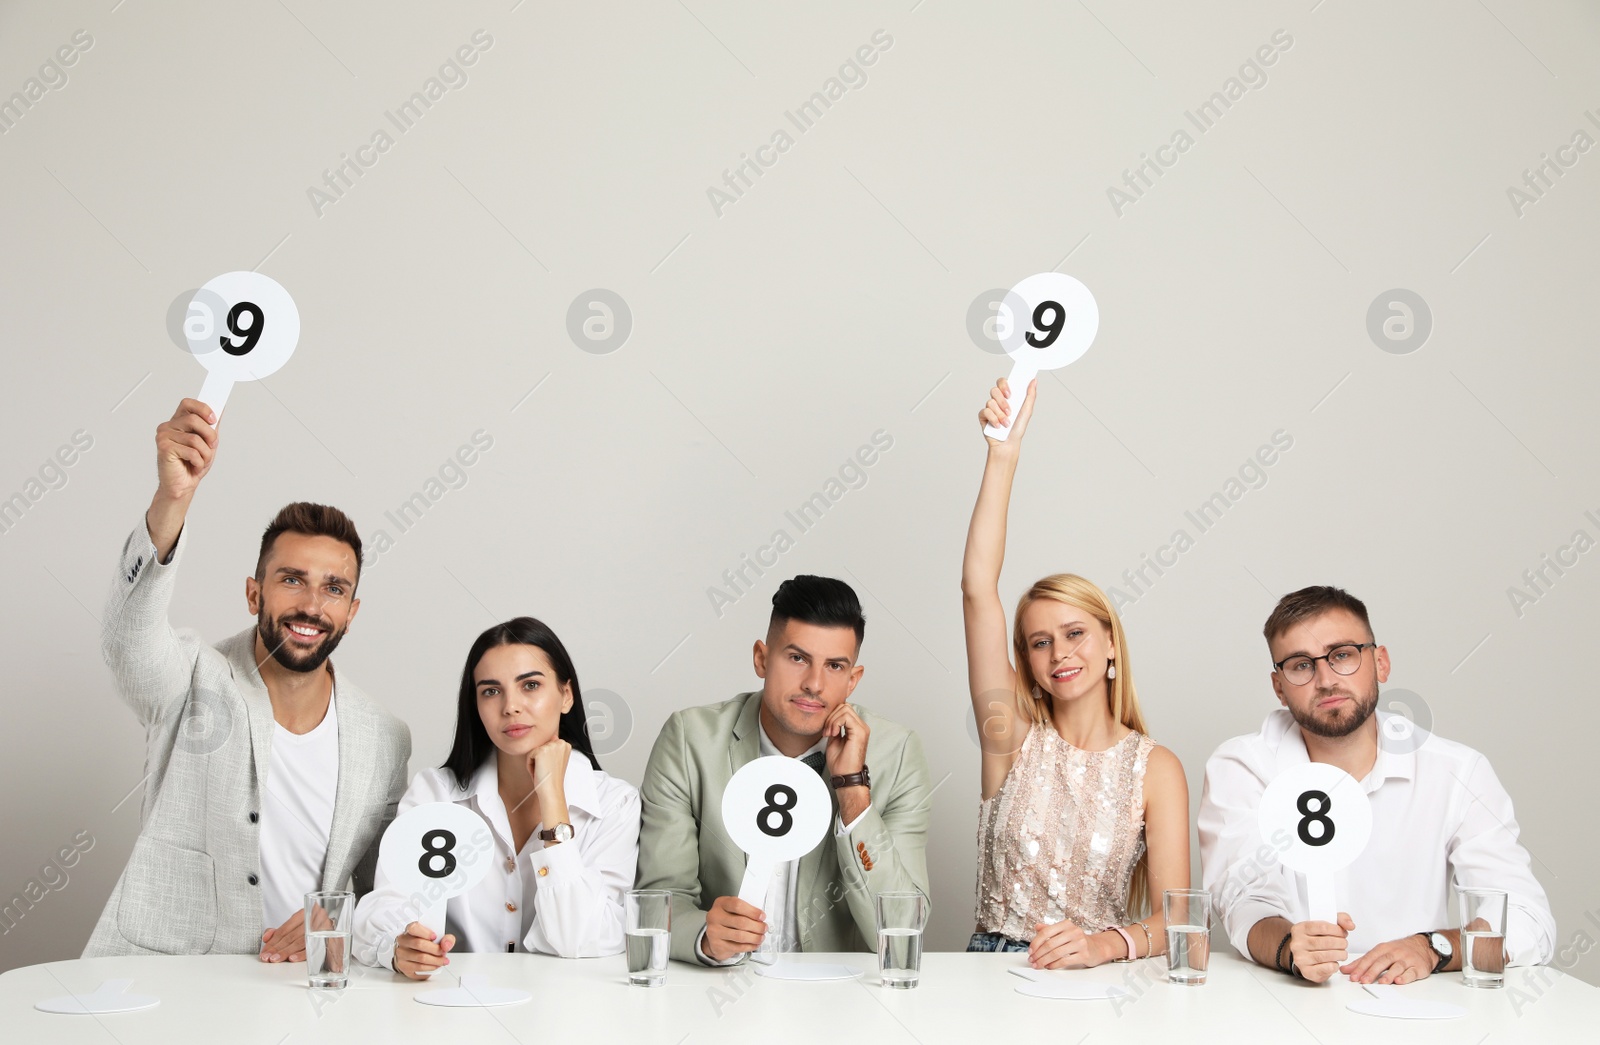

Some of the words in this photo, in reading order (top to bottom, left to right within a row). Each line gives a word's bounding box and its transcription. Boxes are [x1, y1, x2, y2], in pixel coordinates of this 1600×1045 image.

[219, 301, 265, 356] 9
[1025, 300, 1066, 349] 9
[756, 783, 798, 837] 8
[1296, 790, 1336, 847] 8
[418, 829, 457, 879] 8
